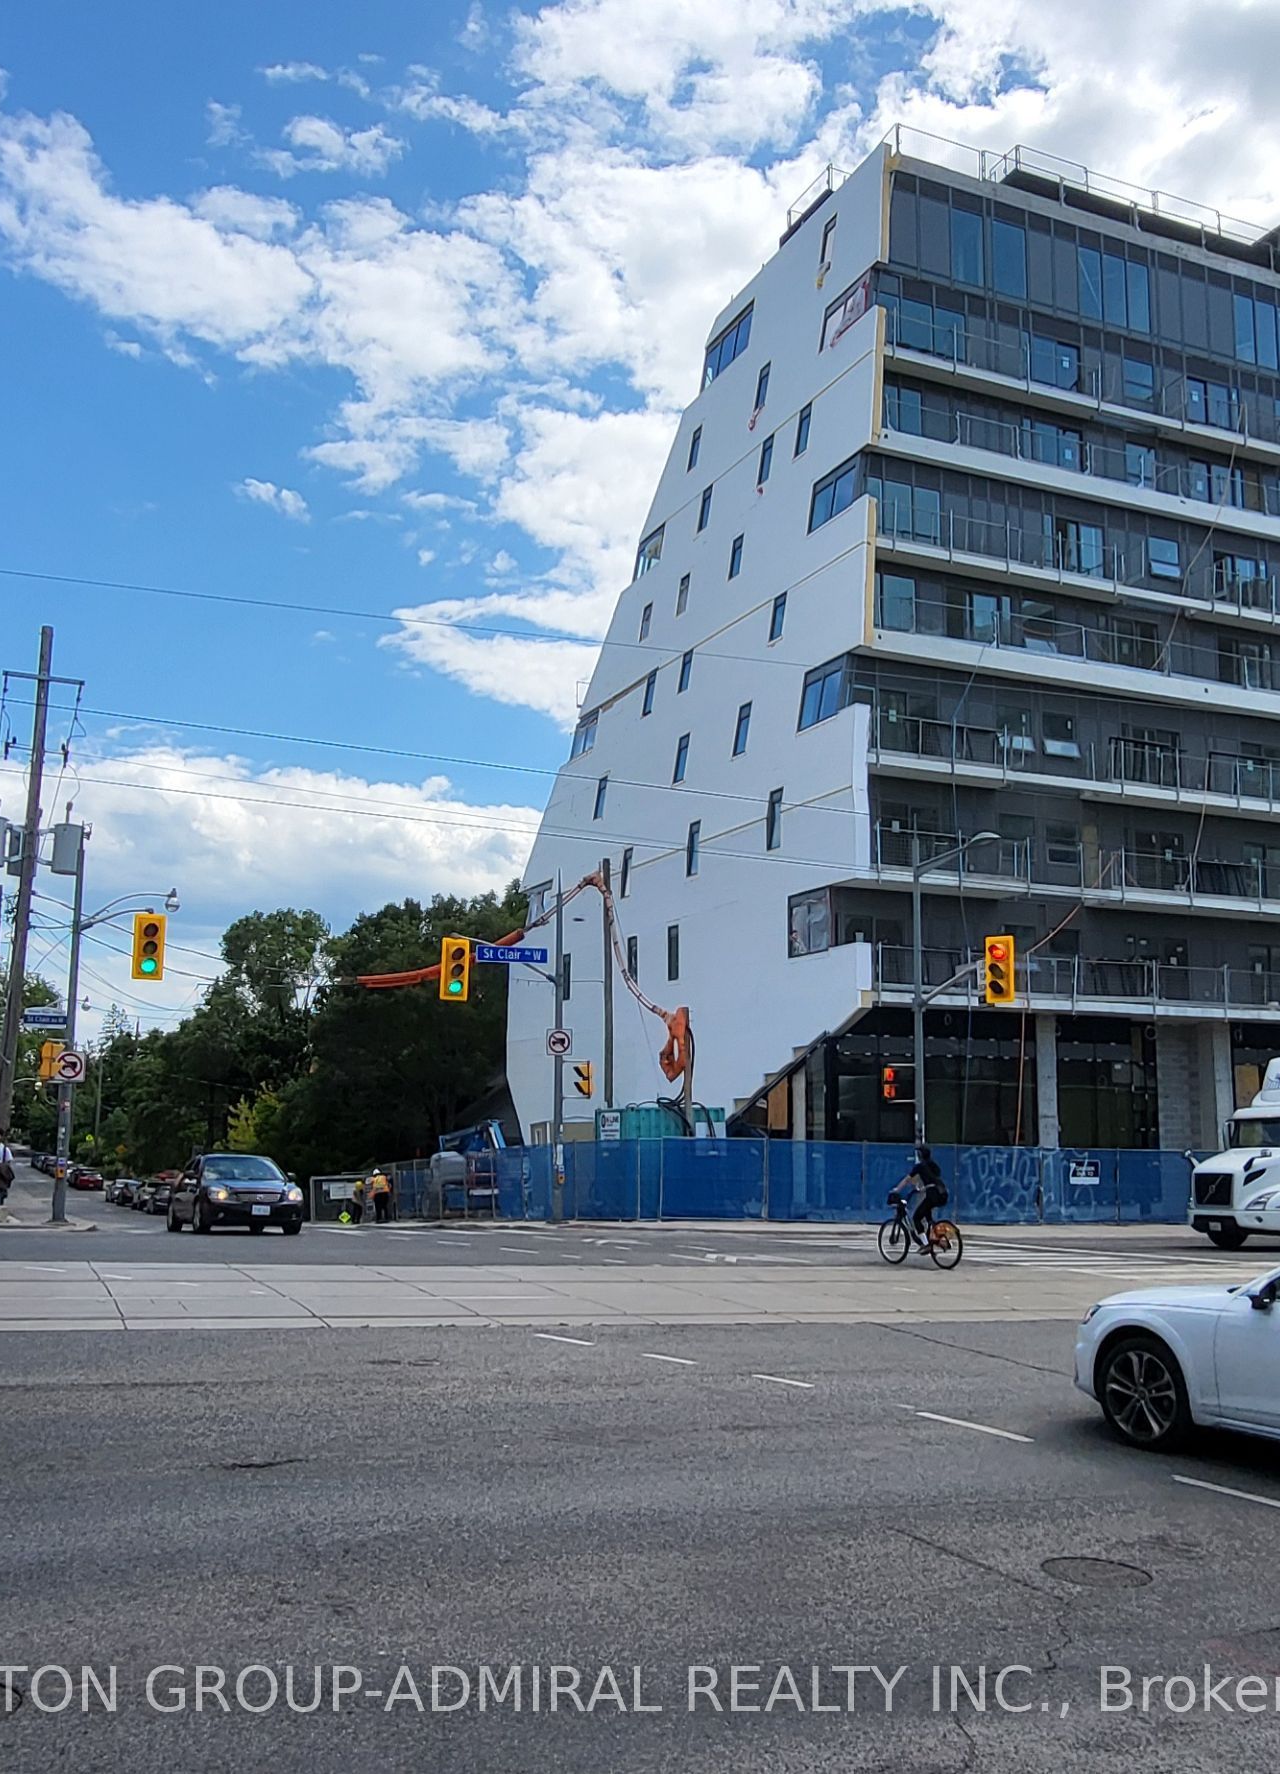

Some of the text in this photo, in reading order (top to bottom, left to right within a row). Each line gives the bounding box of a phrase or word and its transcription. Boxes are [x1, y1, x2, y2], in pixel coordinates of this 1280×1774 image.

[483, 948, 494, 959] St
[497, 948, 522, 960] Clair
[533, 950, 542, 961] W
